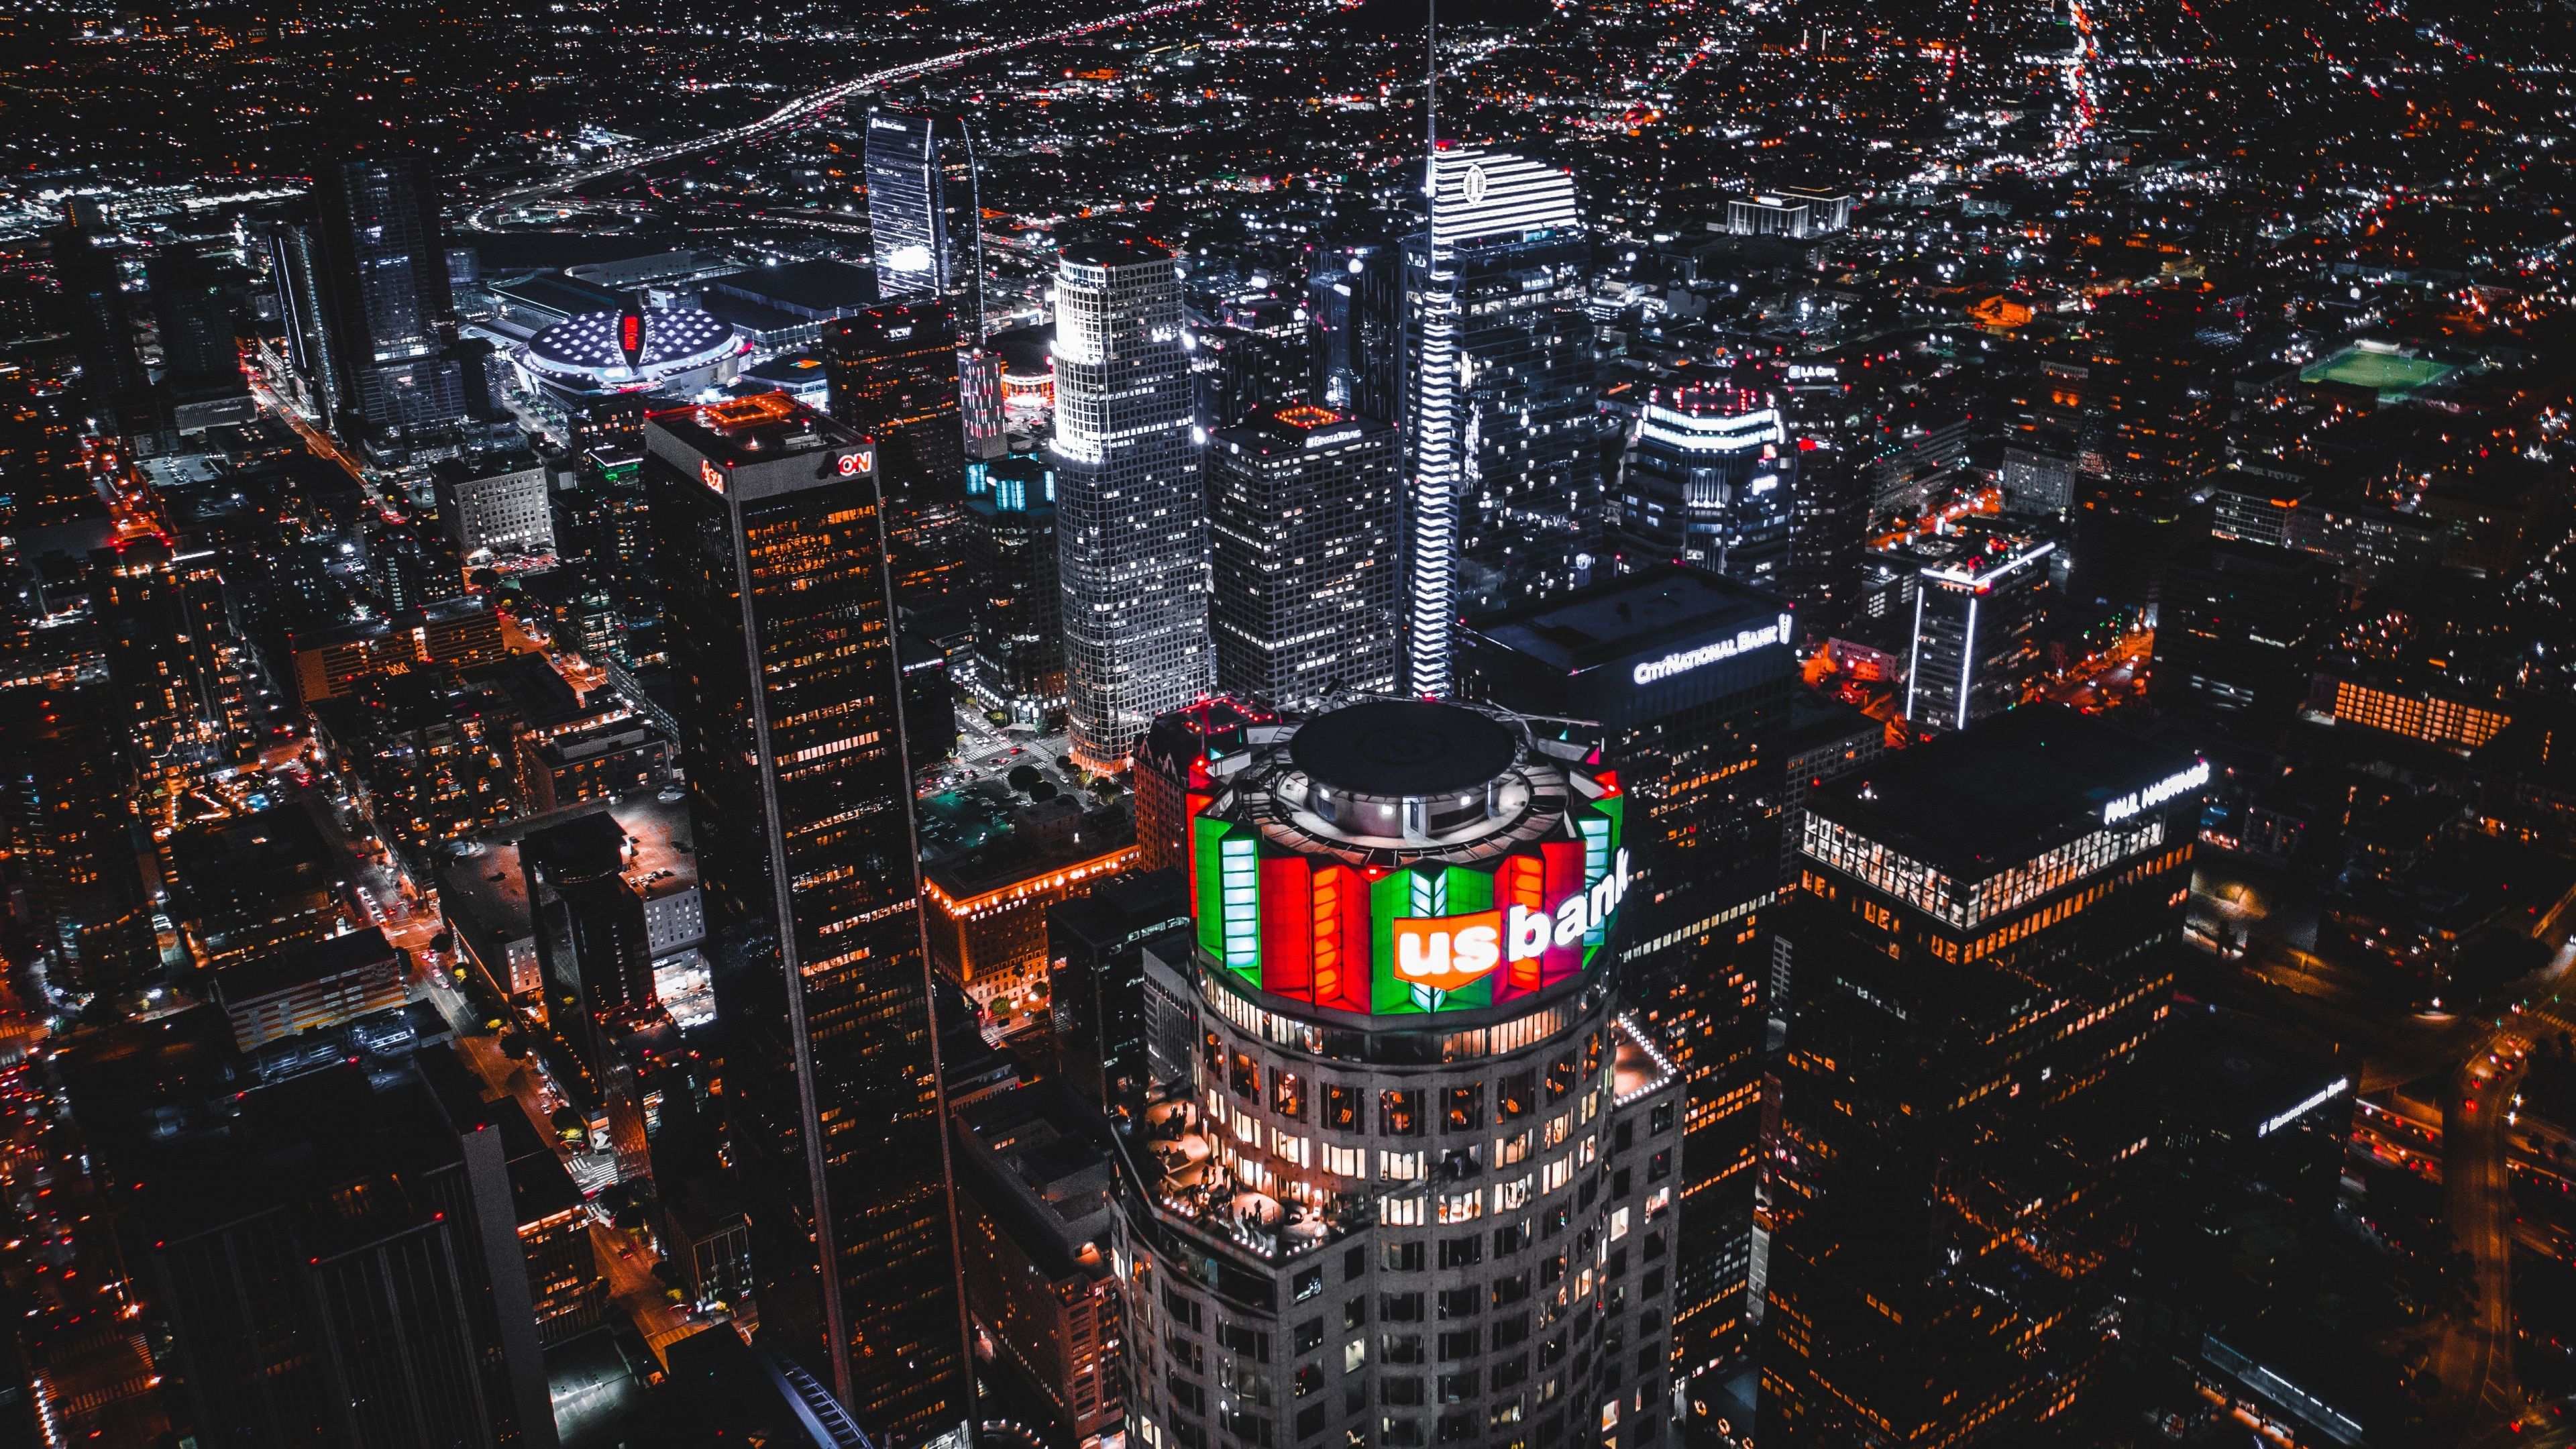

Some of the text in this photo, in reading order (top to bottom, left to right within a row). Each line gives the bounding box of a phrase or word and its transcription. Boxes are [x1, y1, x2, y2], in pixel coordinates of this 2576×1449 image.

[889, 327, 912, 338] TCW
[1399, 847, 1629, 976] us bank
